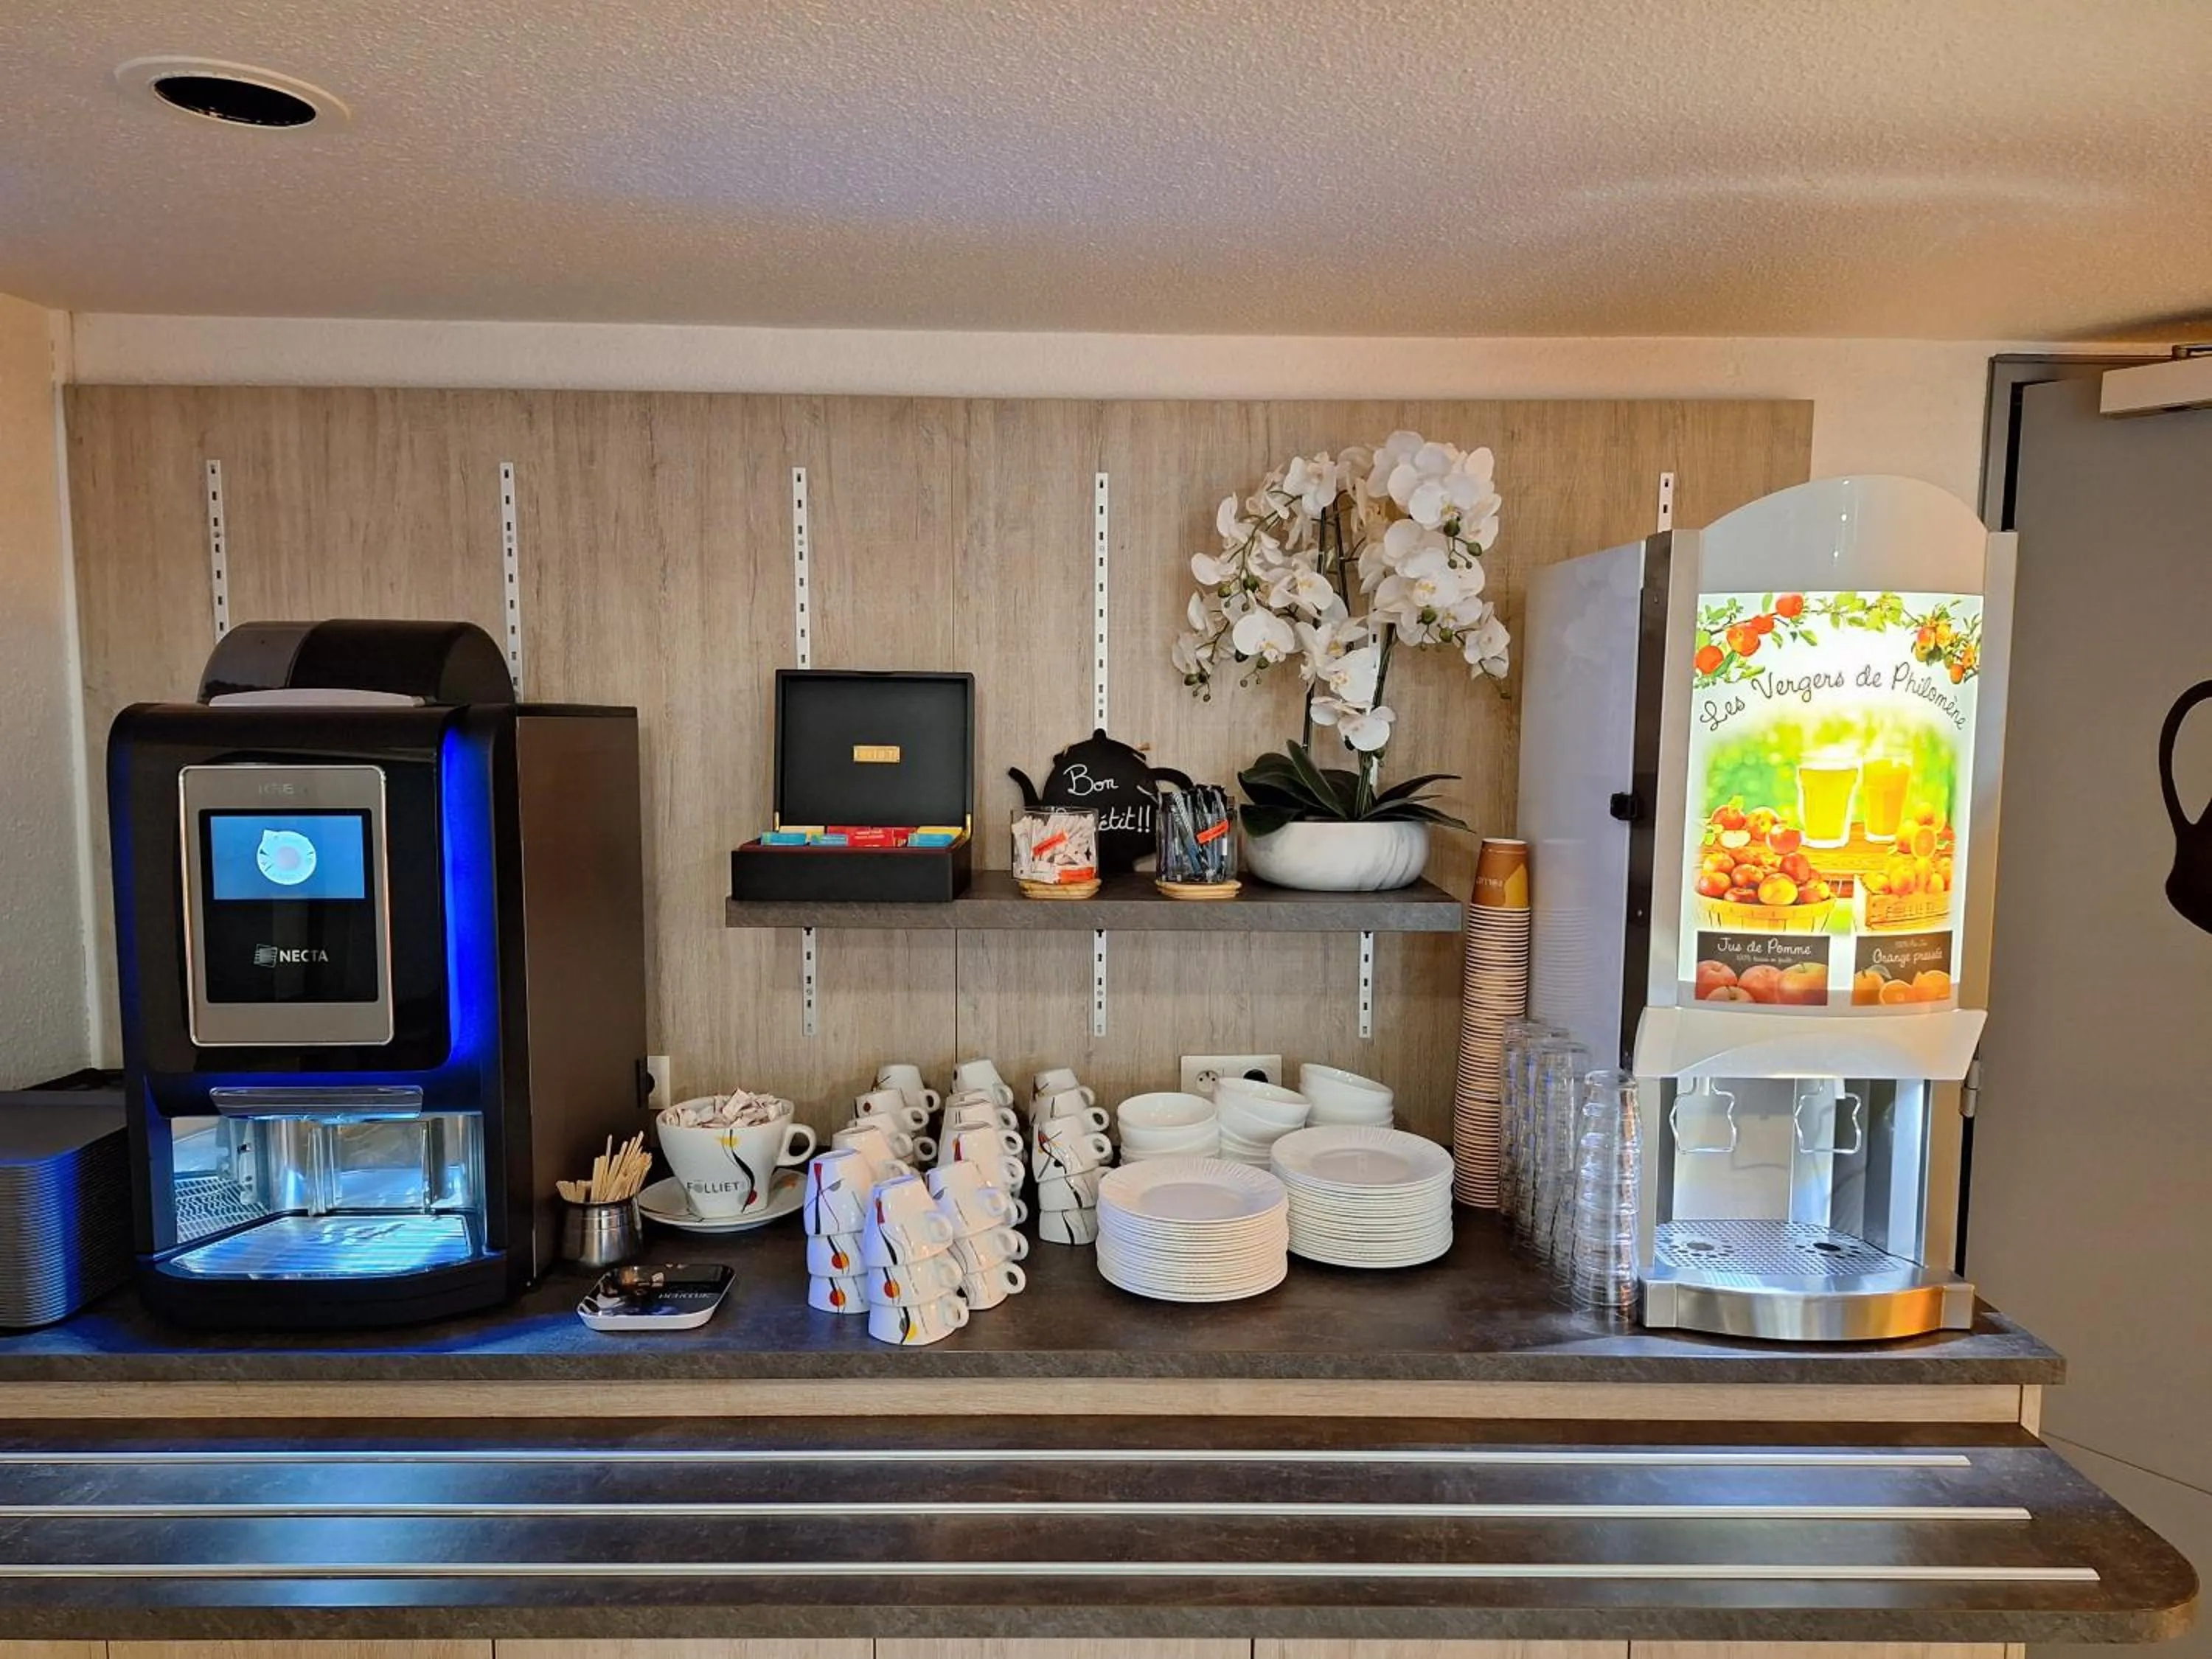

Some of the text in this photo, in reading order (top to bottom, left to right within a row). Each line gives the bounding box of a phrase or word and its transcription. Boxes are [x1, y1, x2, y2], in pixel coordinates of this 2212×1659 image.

[1699, 661, 1967, 731] Les Vergers de Philomène
[1062, 763, 1119, 796] Bon
[1097, 804, 1152, 833] étit!!
[279, 948, 329, 964] NECTA
[1717, 937, 1812, 956] Jus de Pomme
[686, 1180, 740, 1194] FOLLIET
